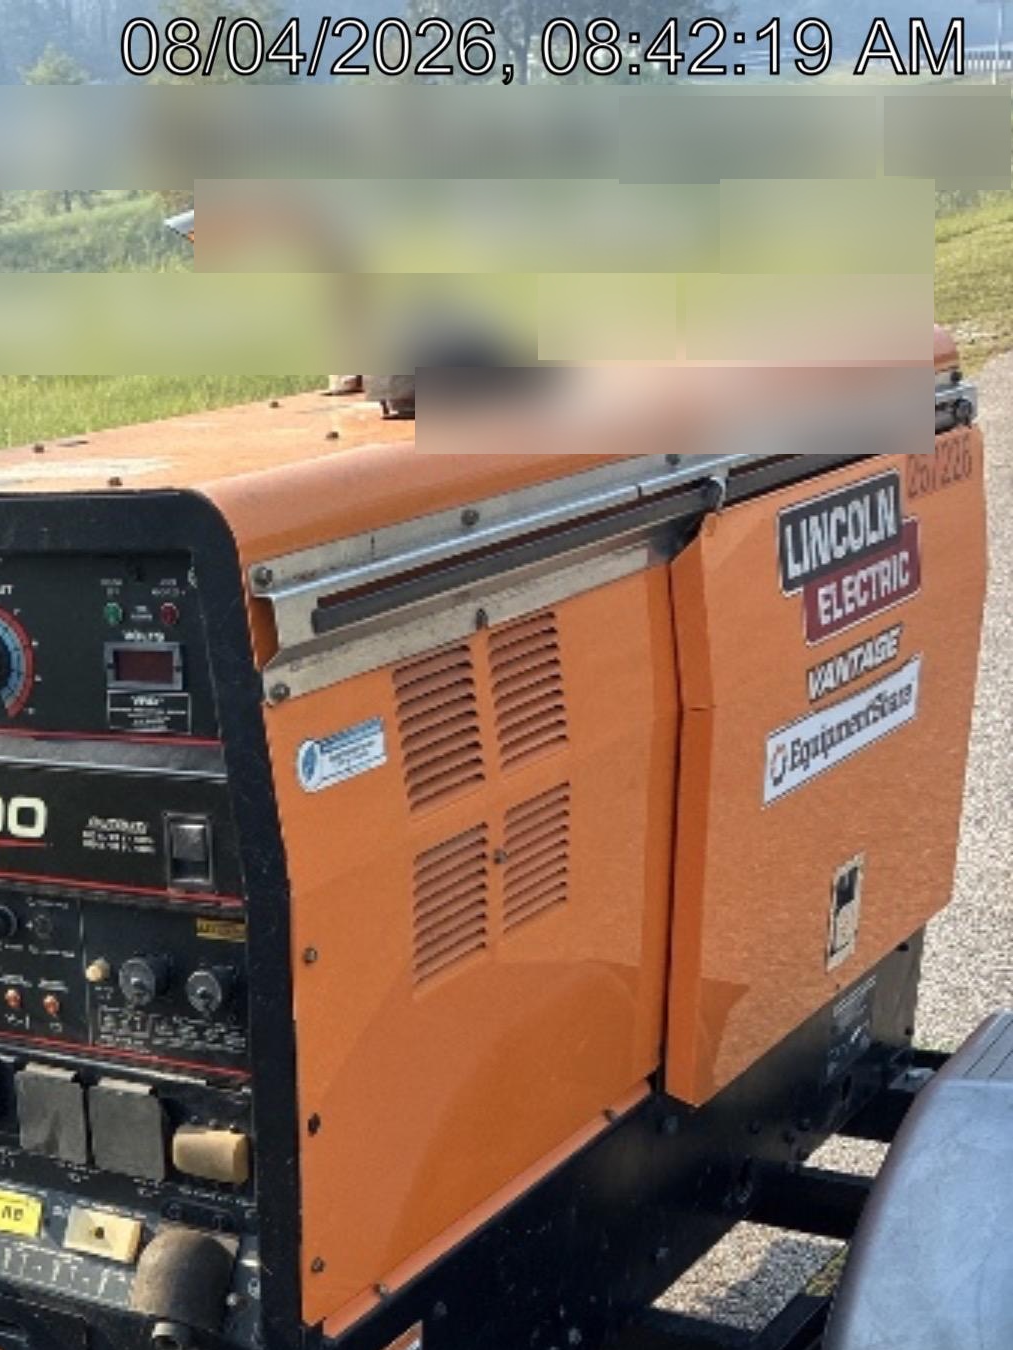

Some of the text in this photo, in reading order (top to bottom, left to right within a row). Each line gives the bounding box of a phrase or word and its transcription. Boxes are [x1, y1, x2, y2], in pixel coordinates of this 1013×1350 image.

[784, 485, 898, 580] LINCOLN
[817, 550, 910, 626] ELECTRIC
[806, 627, 902, 701] VANTAGE
[789, 682, 913, 771] EquipmentShare
